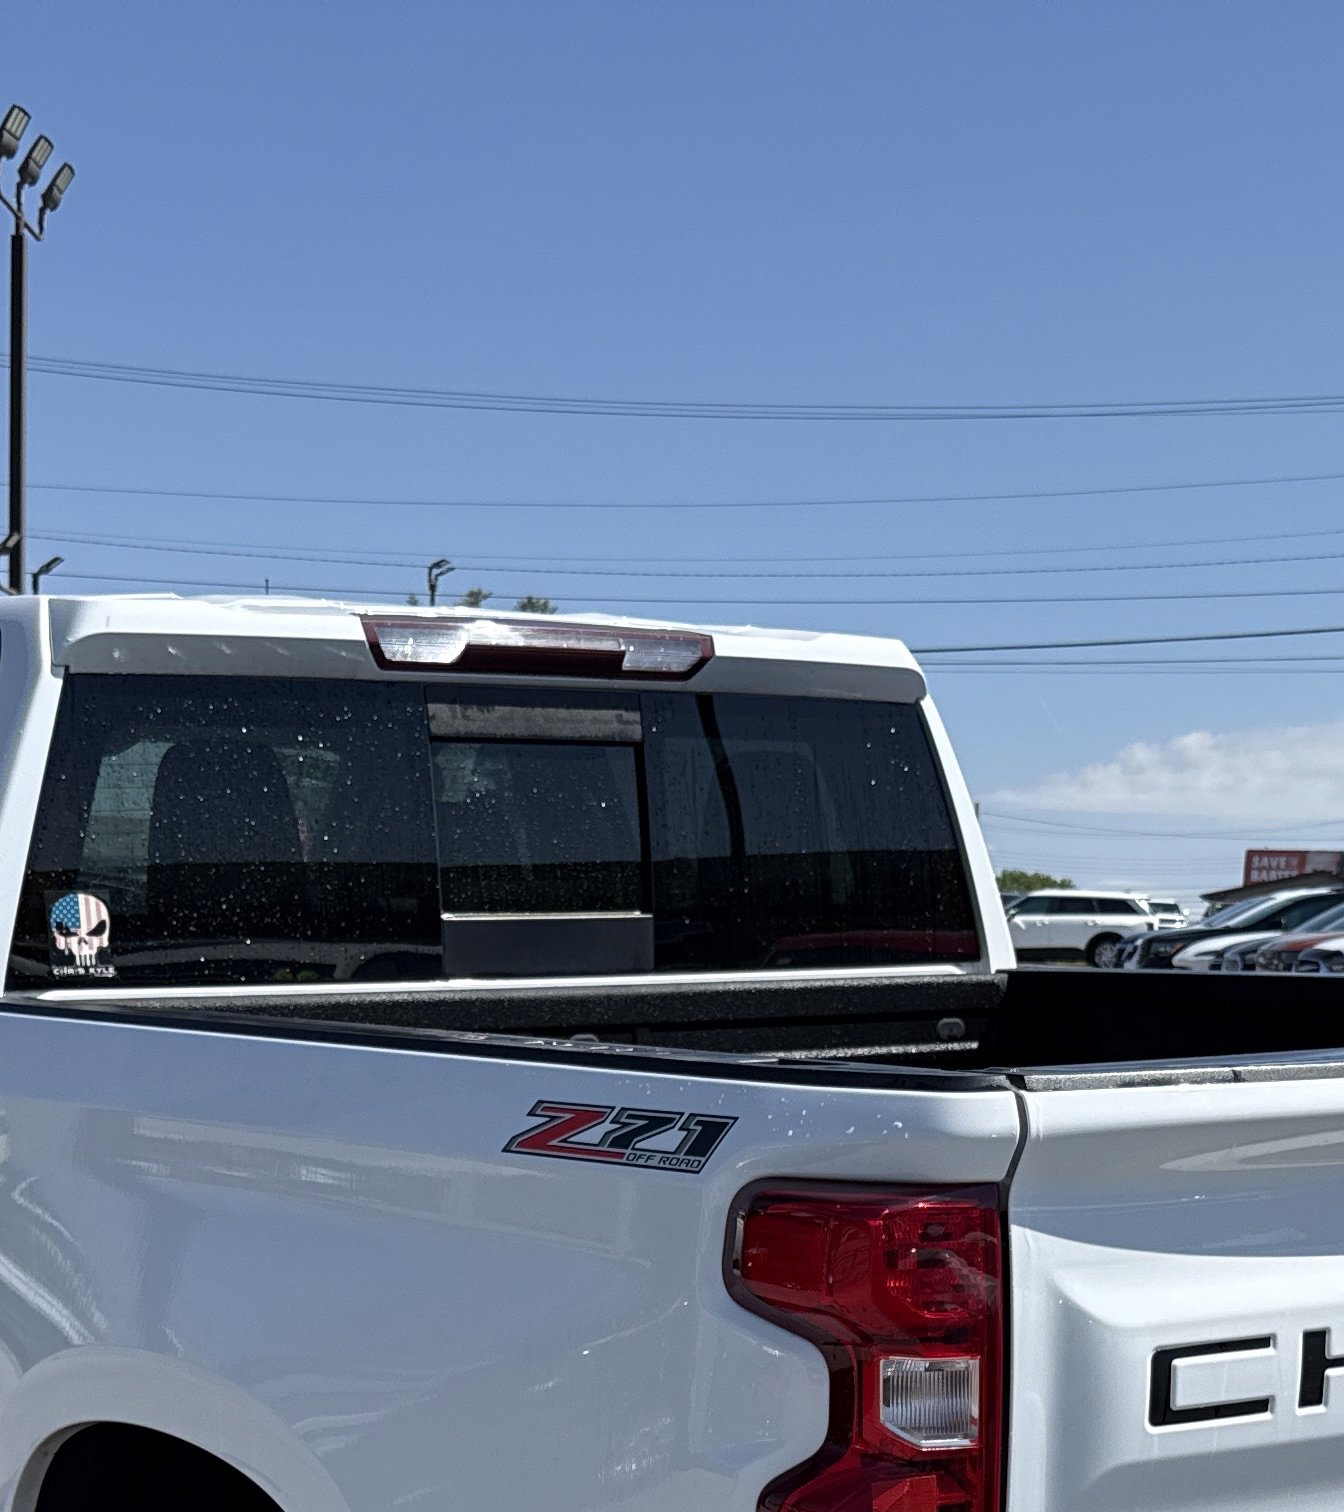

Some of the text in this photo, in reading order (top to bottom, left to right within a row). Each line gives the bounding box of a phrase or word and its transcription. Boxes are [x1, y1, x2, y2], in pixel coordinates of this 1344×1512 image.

[1252, 855, 1287, 866] SAVE
[503, 1100, 739, 1174] Z71
[625, 1152, 702, 1169] OFF ROAD
